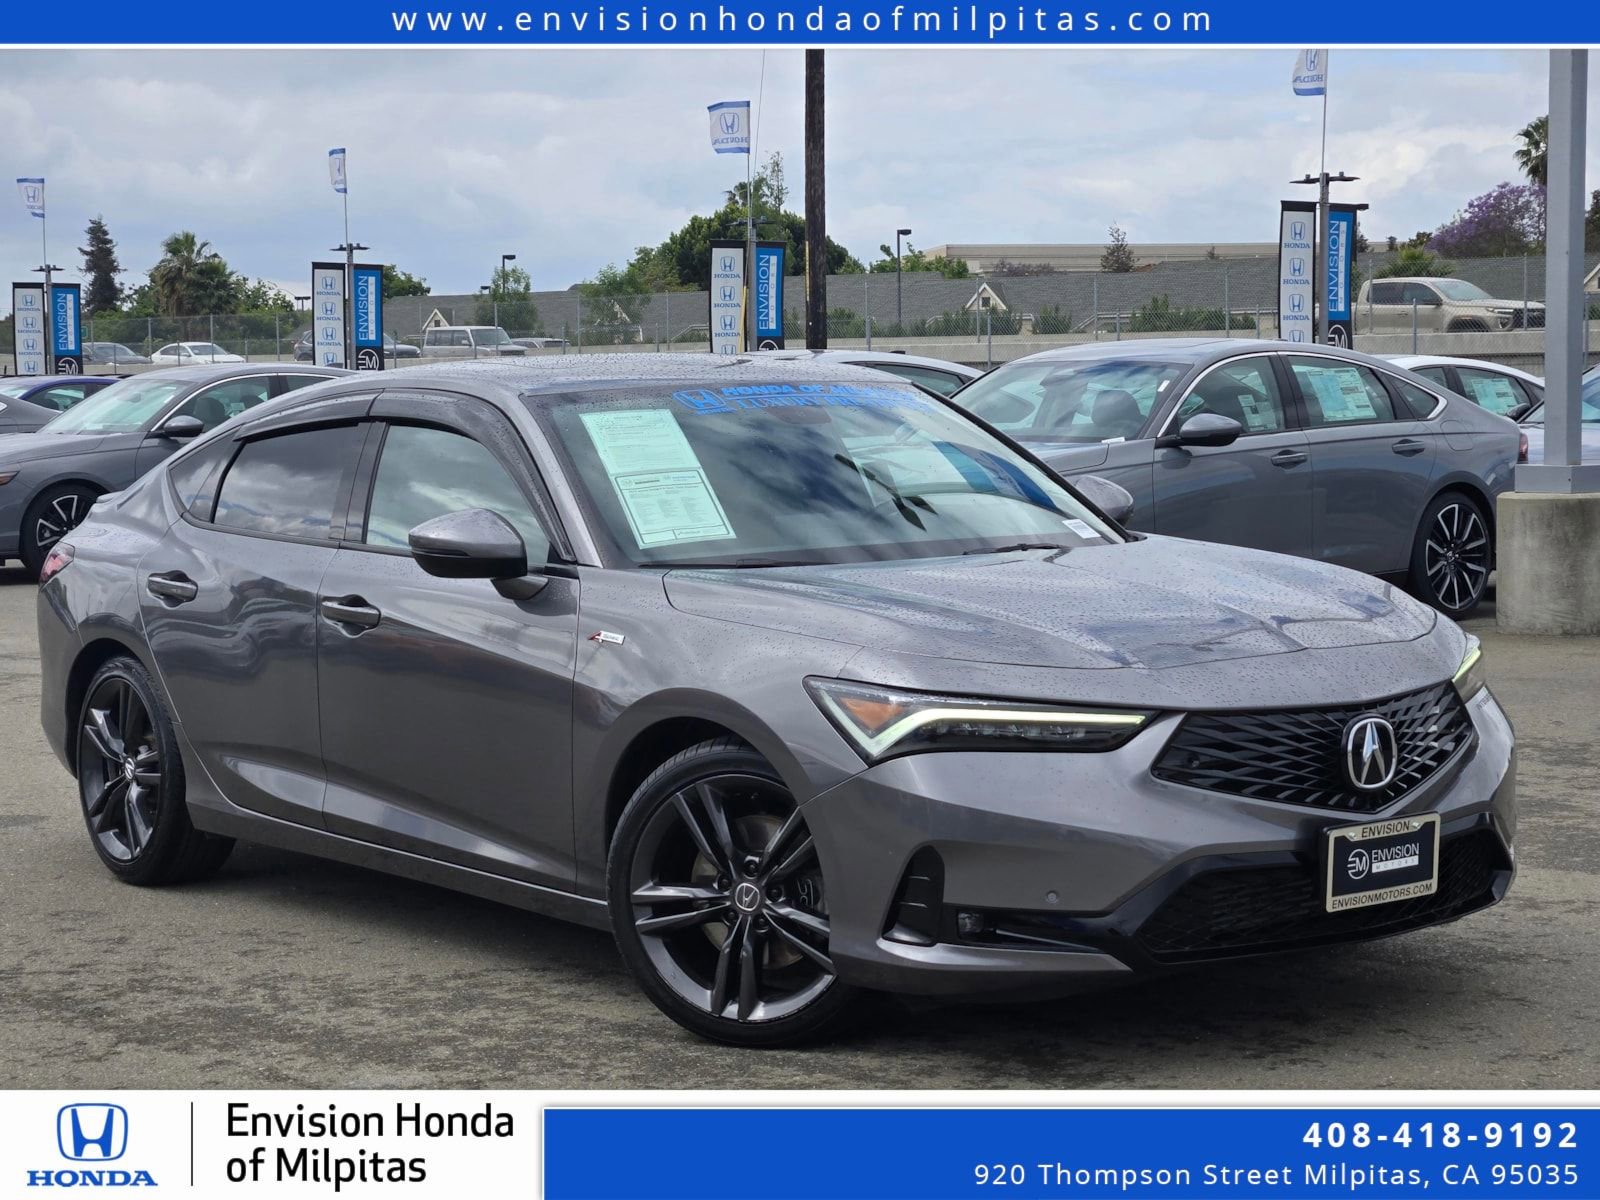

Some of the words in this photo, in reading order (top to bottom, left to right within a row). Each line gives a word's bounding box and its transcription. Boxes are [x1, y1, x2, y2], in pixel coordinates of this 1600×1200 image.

[1329, 220, 1340, 312] ENVISION
[358, 275, 368, 341] ENVISION
[759, 254, 770, 330] ENVISION
[56, 293, 68, 351] ENVISION
[721, 384, 796, 396] HONDA
[799, 384, 824, 393] OF
[1361, 820, 1411, 839] ENVISION
[1371, 842, 1420, 863] ENVISION
[1331, 882, 1433, 910] ENVISIONMOTORS.COM
